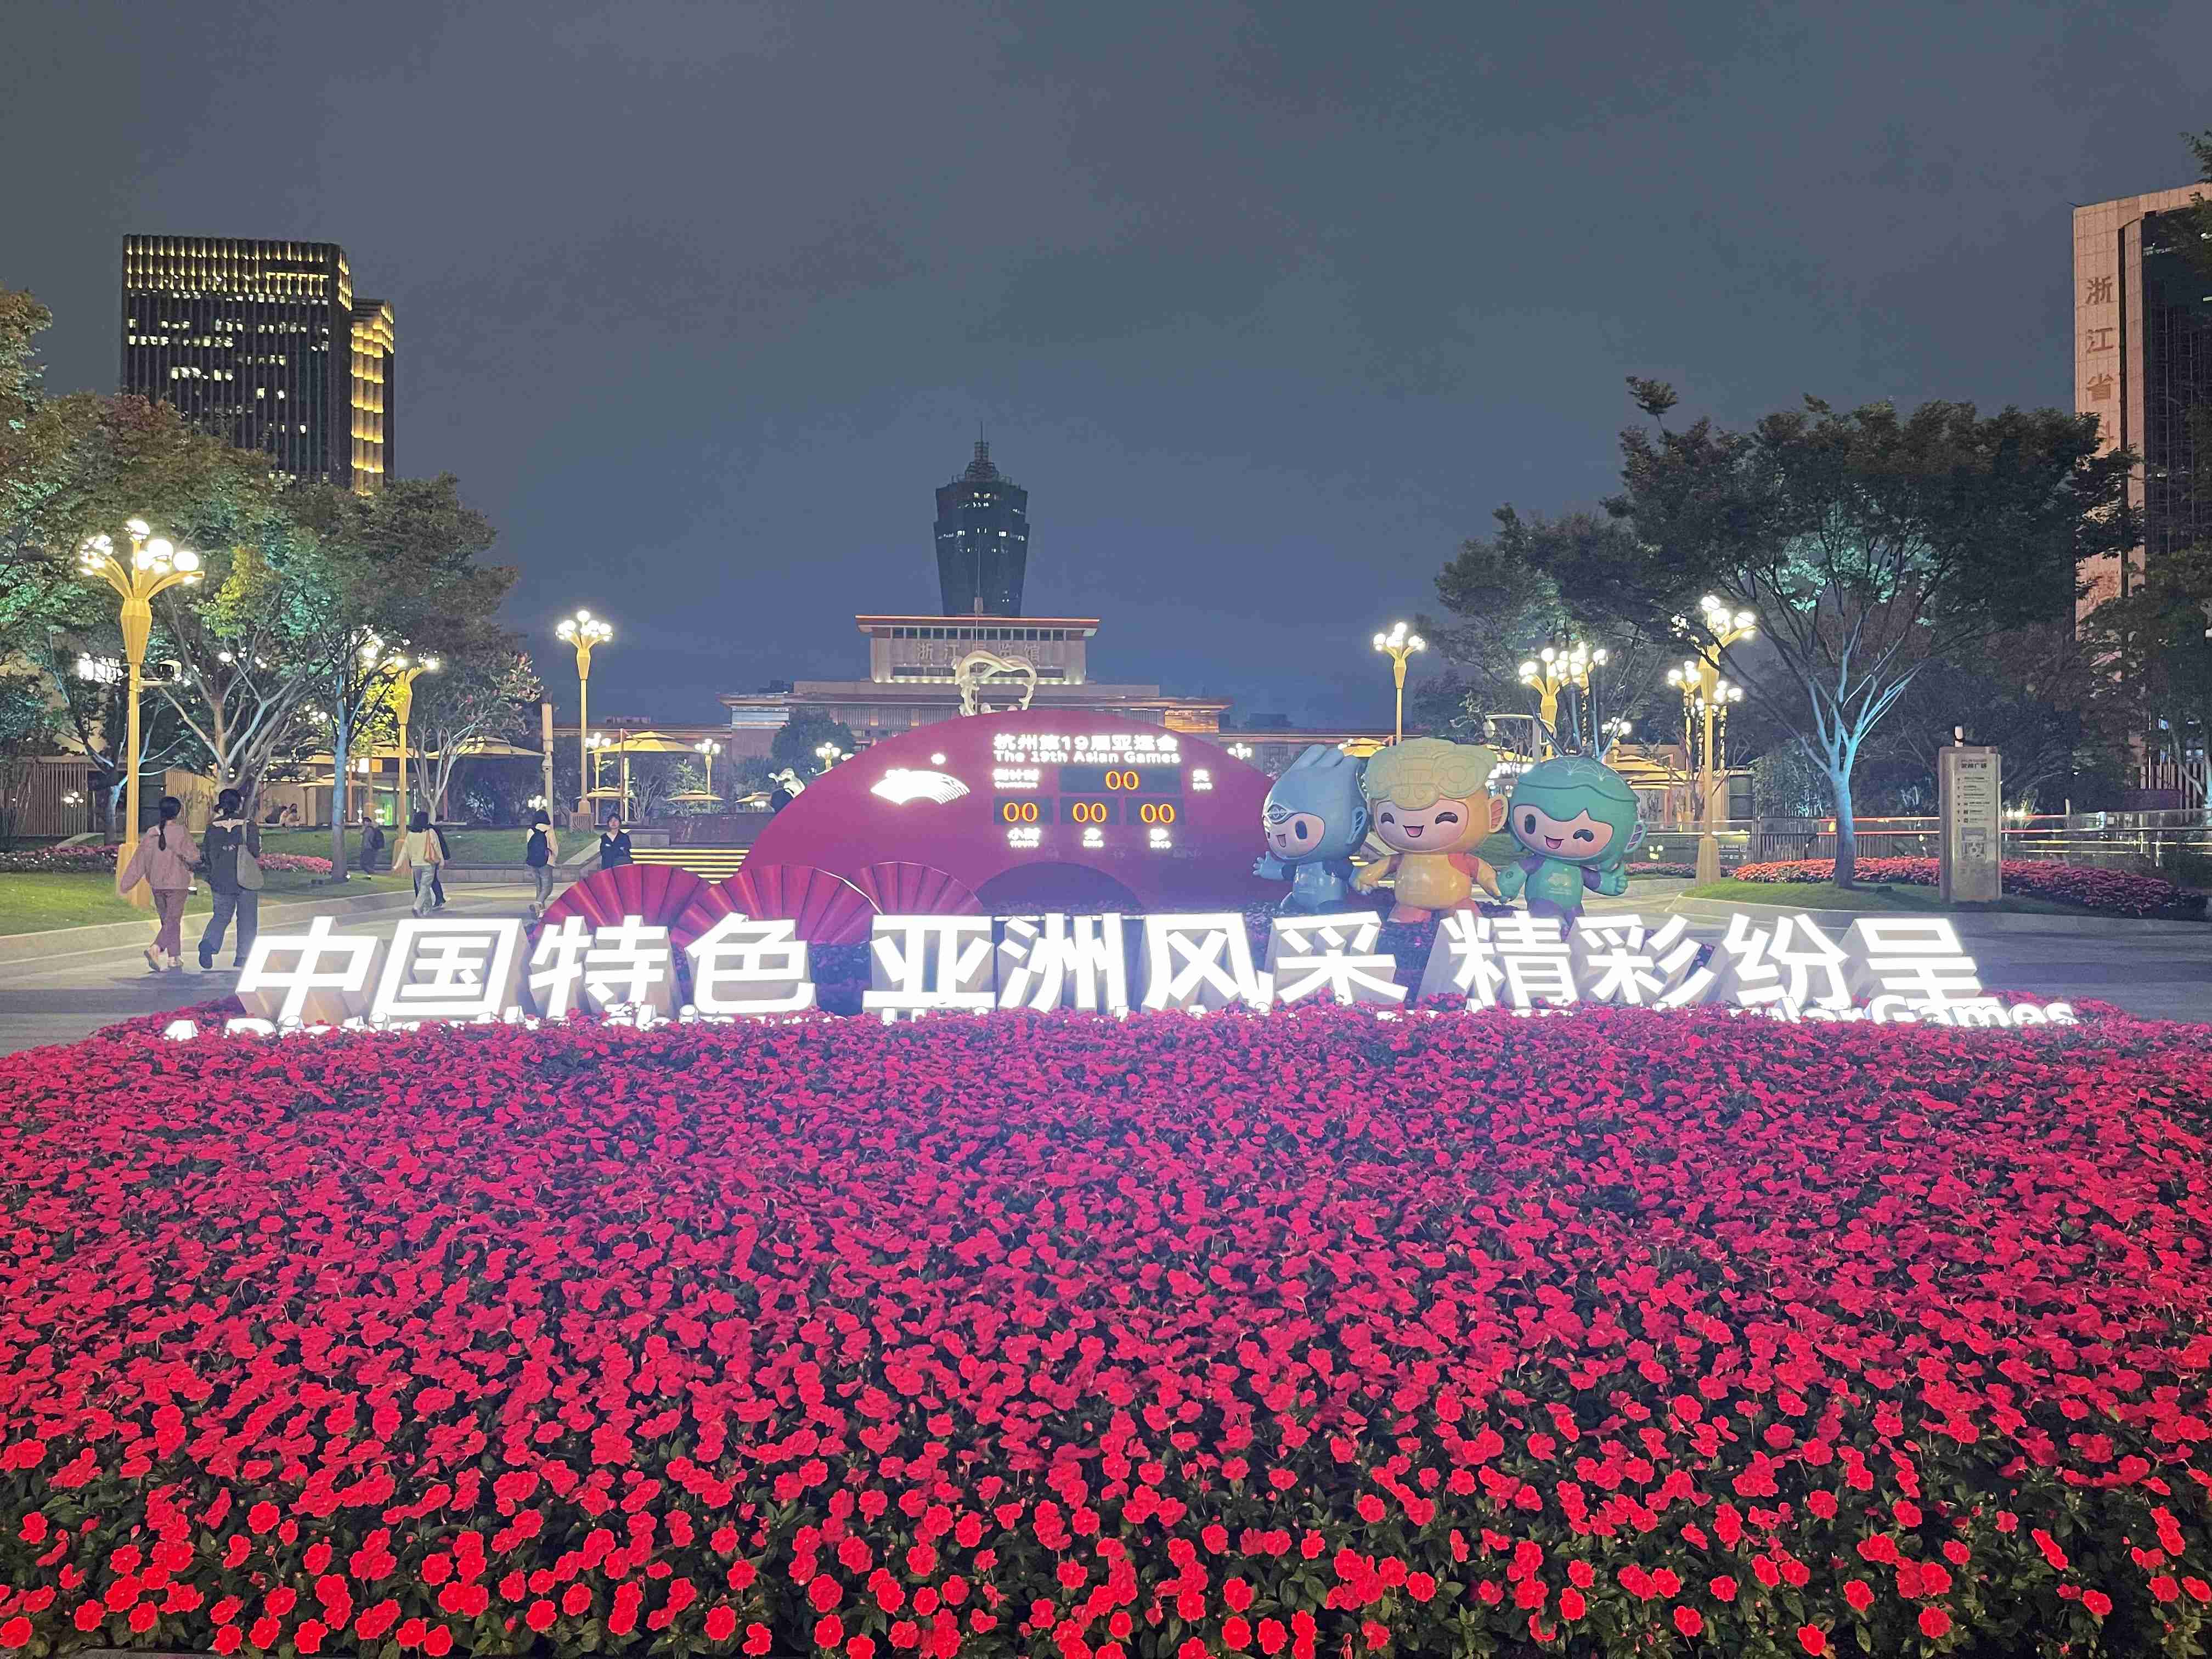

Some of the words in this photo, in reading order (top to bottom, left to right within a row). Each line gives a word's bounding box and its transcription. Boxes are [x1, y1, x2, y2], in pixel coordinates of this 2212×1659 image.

[994, 751, 1025, 763] The
[1030, 751, 1068, 763] 19th
[1073, 751, 1119, 763] Asian
[1124, 752, 1180, 764] Games
[1105, 771, 1139, 791] 00
[1003, 802, 1038, 822] 00
[1072, 802, 1107, 823] 00
[1141, 803, 1175, 823] 00
[235, 911, 815, 1022] 中国特色
[862, 911, 1408, 1015] 亚洲风采
[1441, 908, 2000, 1015] 精彩纷呈
